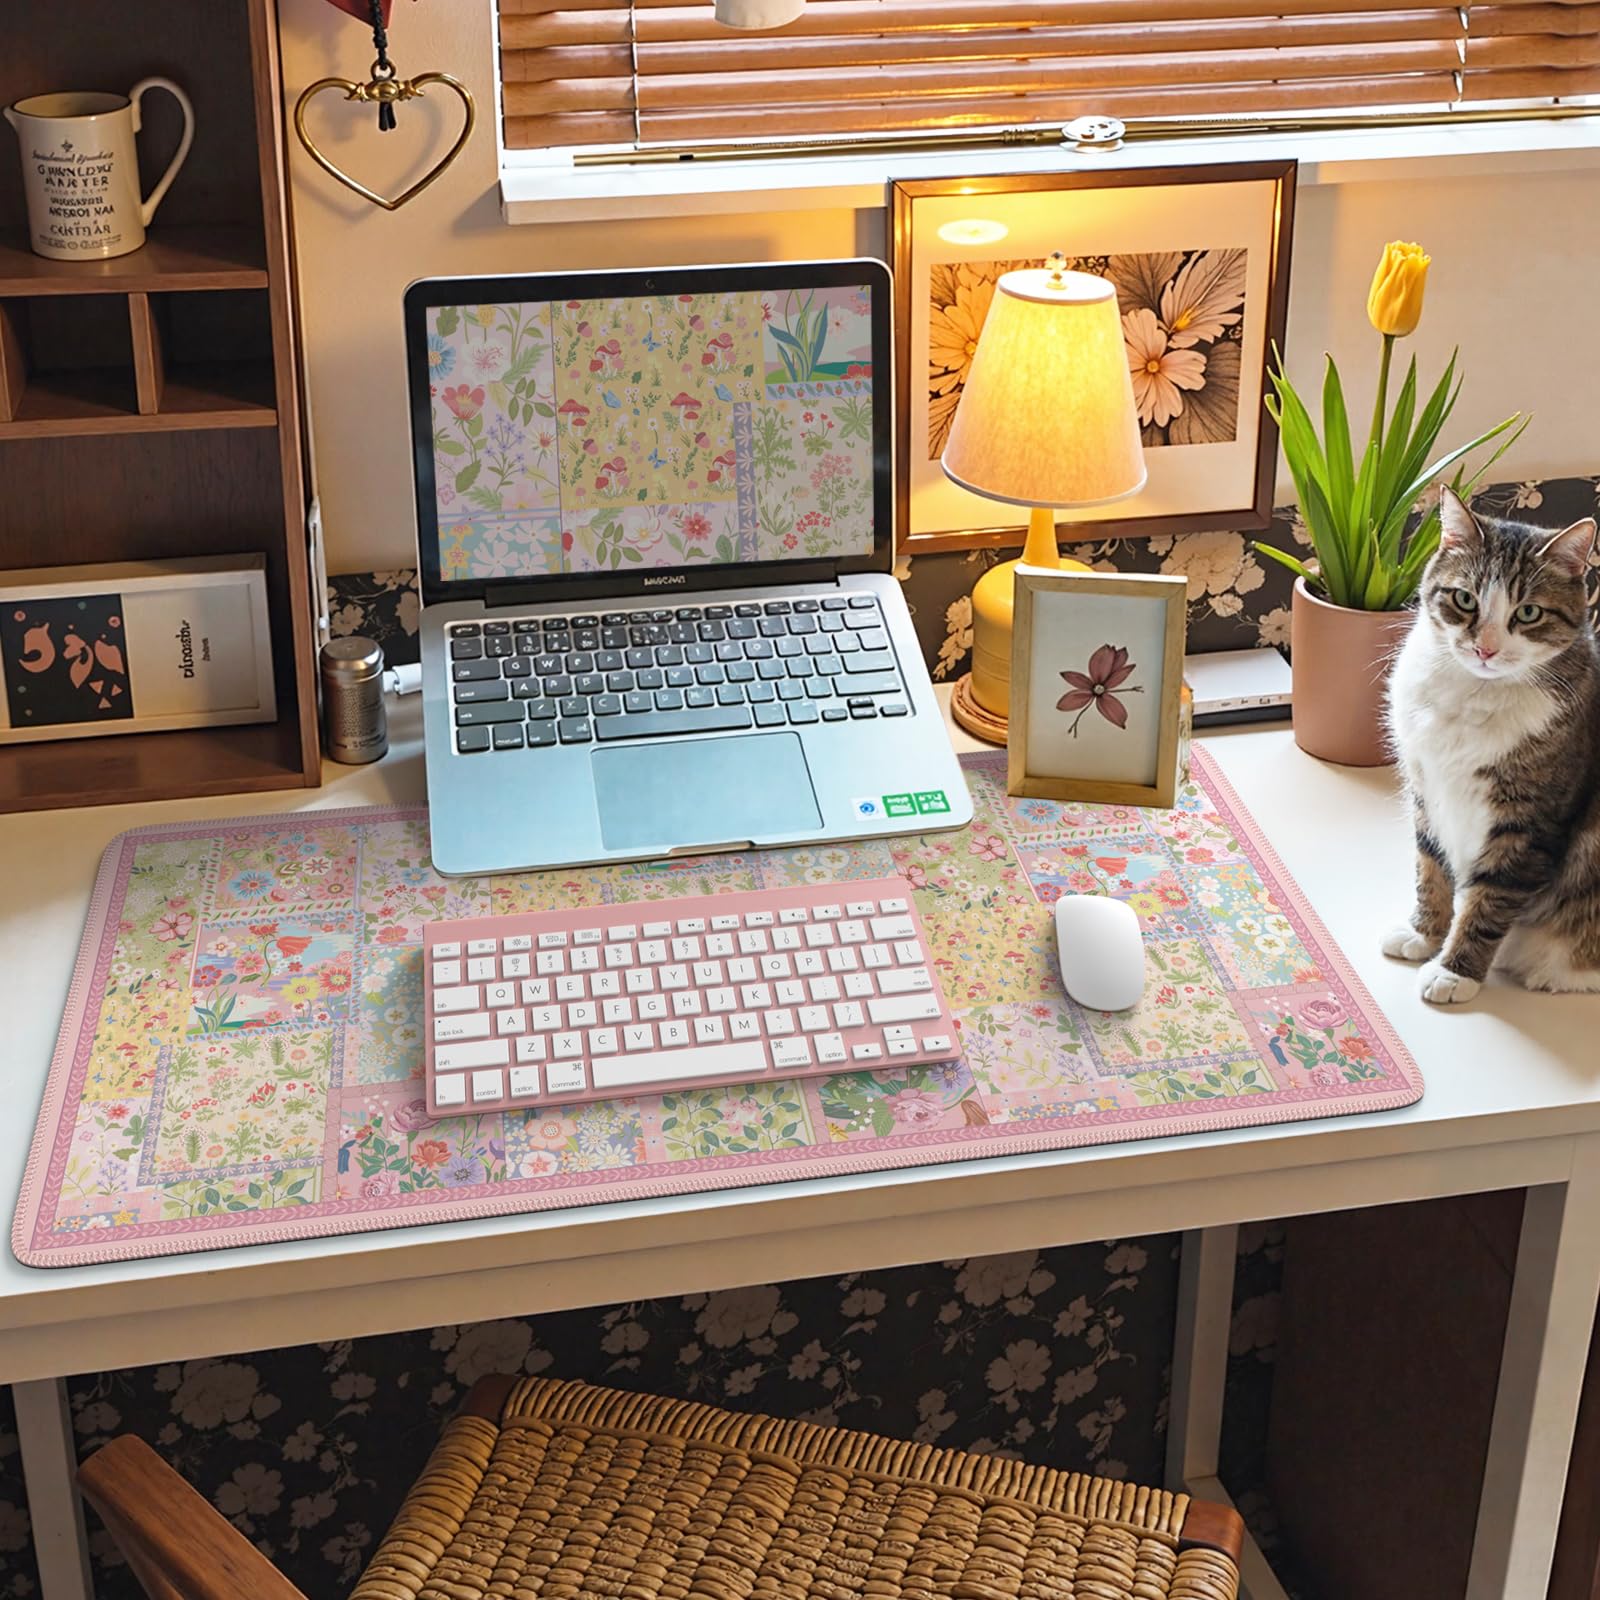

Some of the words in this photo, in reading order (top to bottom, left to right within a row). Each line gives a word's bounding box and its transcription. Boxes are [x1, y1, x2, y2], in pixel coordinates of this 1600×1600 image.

[496, 989, 505, 998] Q
[529, 985, 541, 994] W
[567, 982, 573, 991] E
[601, 978, 608, 987] R
[636, 975, 642, 983] T
[670, 972, 677, 980] Y
[704, 968, 711, 976] U
[771, 961, 780, 969] O
[806, 958, 812, 966] P
[507, 1016, 515, 1024] A
[544, 1012, 550, 1021] S
[577, 1009, 585, 1018] D
[614, 1005, 619, 1014] F
[648, 1001, 656, 1010] G
[682, 998, 691, 1006] H
[752, 991, 759, 999] K
[787, 987, 793, 996] L
[528, 1043, 535, 1052] Z
[563, 1039, 571, 1048] X
[598, 1035, 606, 1044] C
[634, 1032, 642, 1040] V
[670, 1028, 677, 1037] B
[705, 1024, 714, 1032] N
[739, 1020, 750, 1029] M
[779, 1054, 807, 1063] command
[825, 1051, 843, 1059] option
[551, 1080, 580, 1088] command
[476, 1088, 497, 1097] control
[514, 1085, 534, 1093] option
